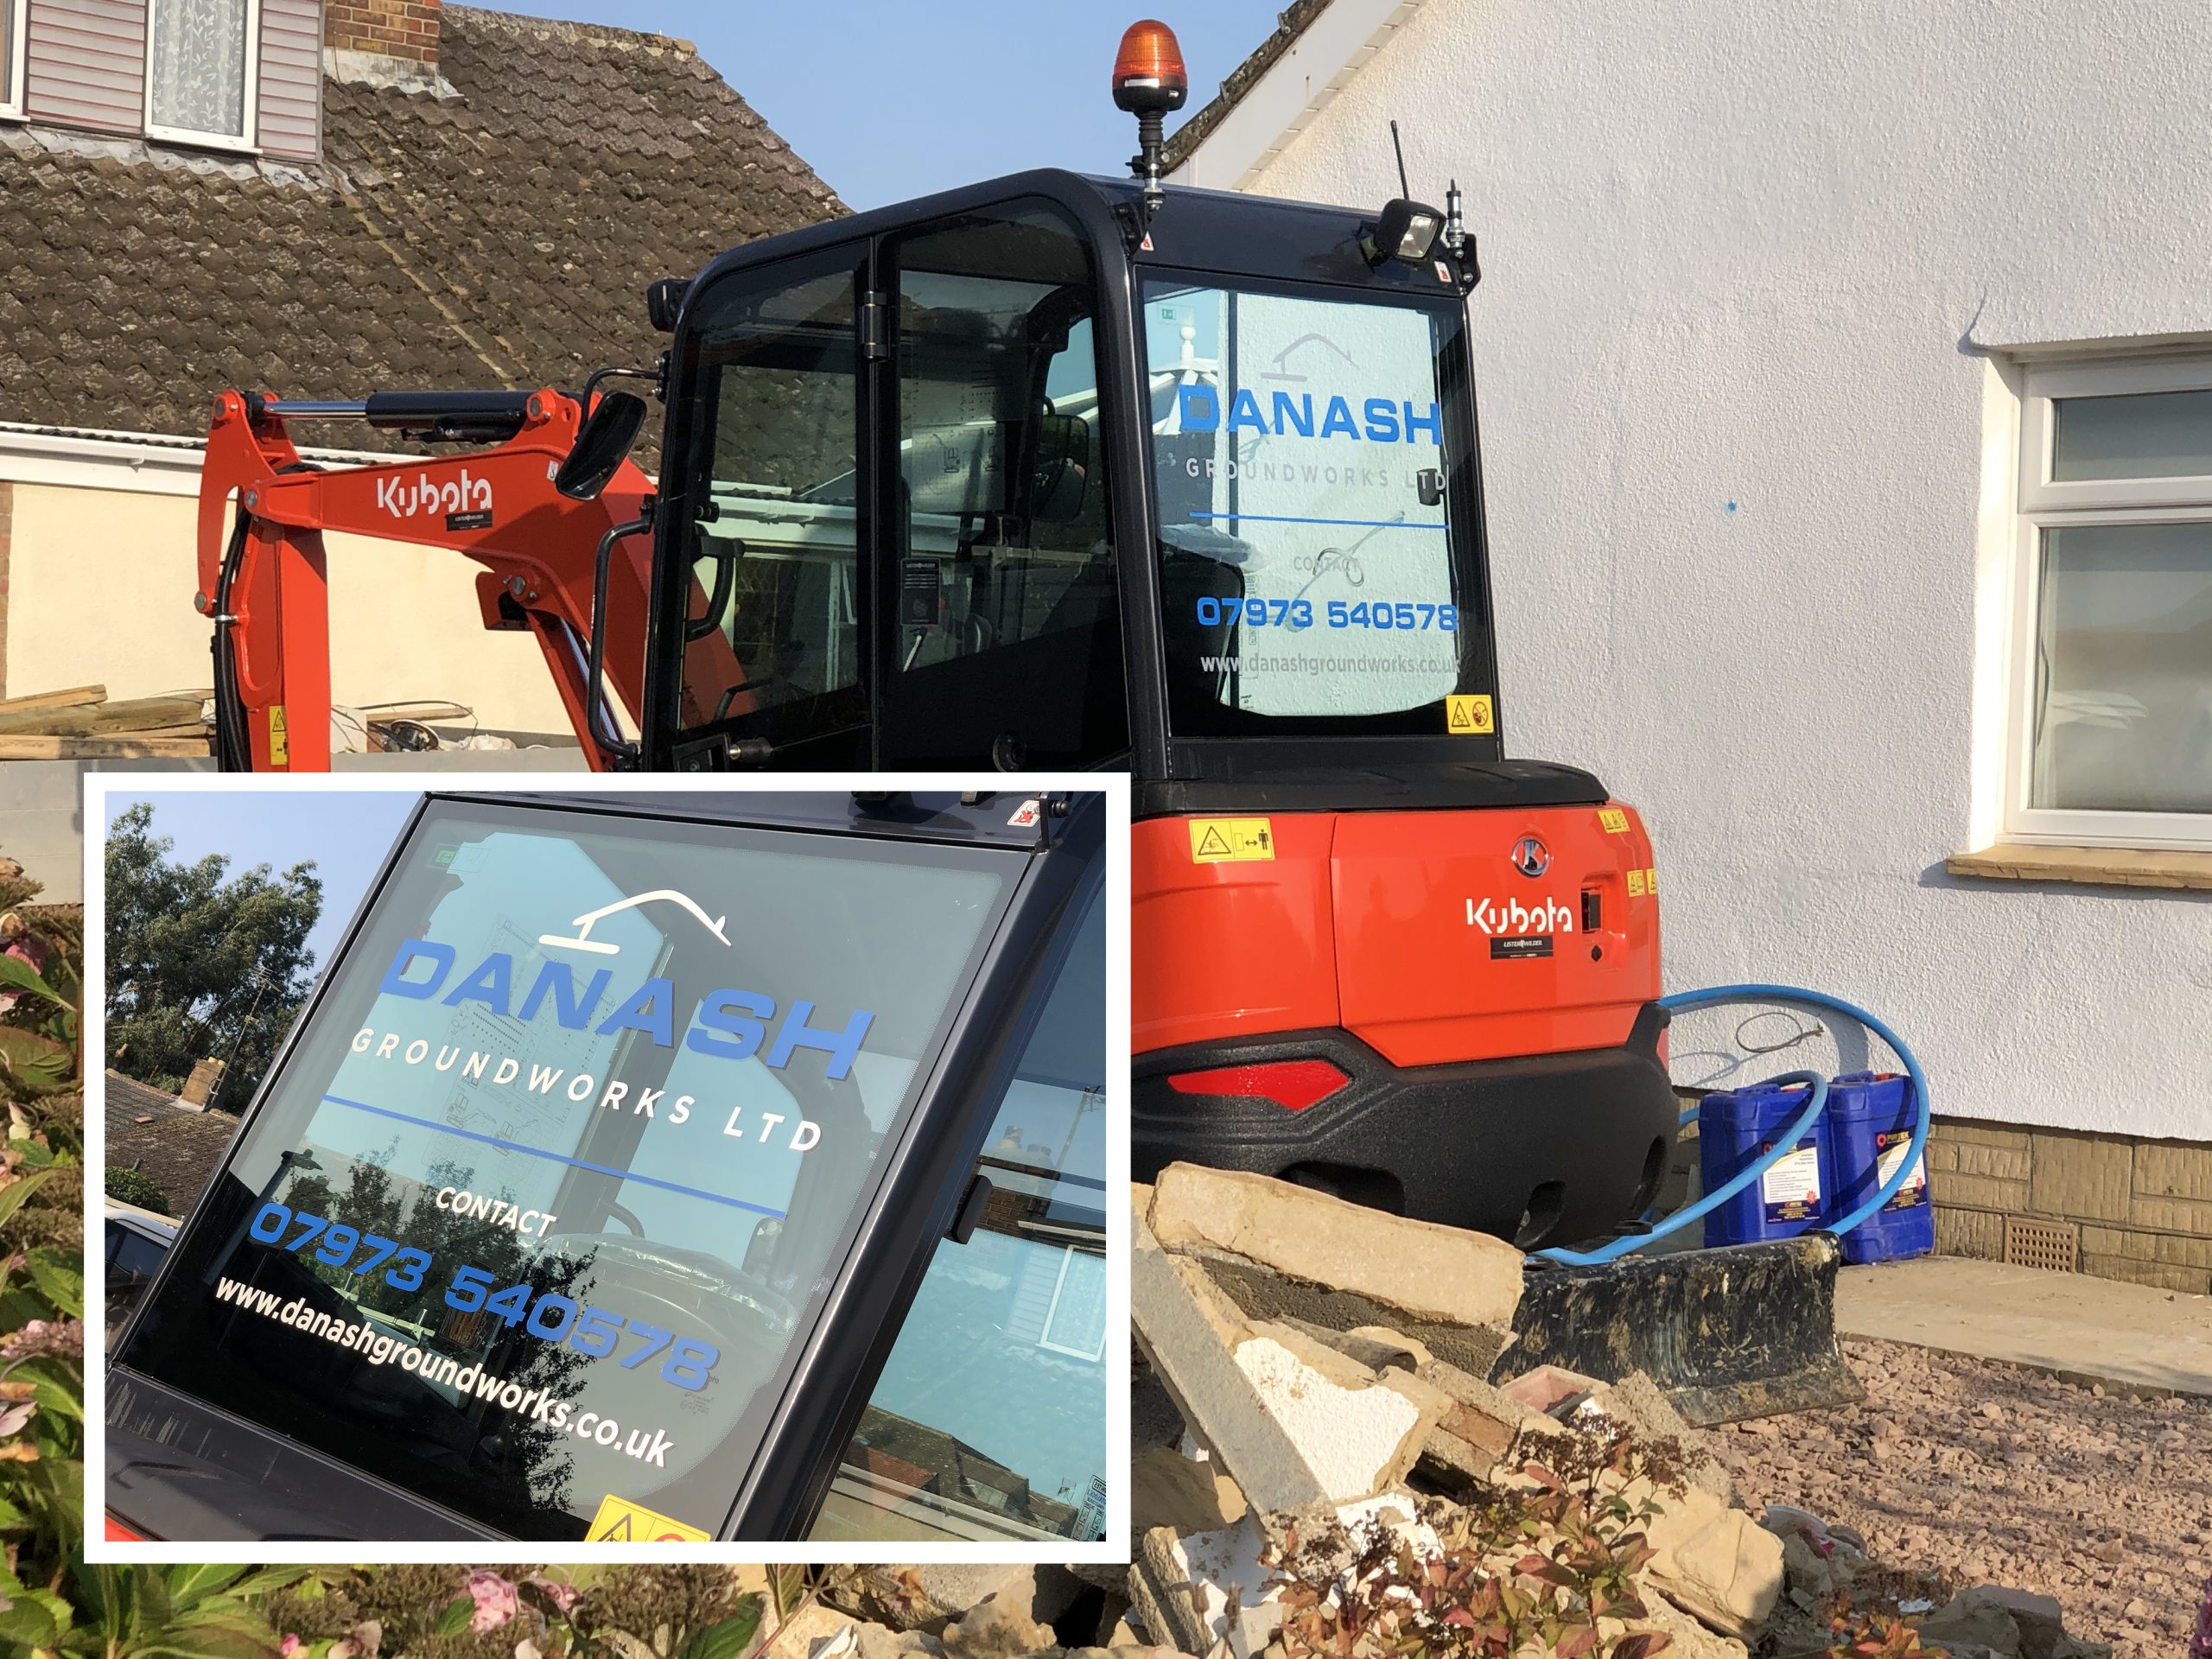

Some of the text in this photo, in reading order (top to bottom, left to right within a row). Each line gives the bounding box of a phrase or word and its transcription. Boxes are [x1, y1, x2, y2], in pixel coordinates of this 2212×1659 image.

[1179, 384, 1442, 445] DANASH
[378, 469, 492, 517] Kubota
[1185, 459, 1446, 491] GROUNDWORKS LTD
[1197, 597, 1459, 631] 07973 540578
[1201, 654, 1460, 677] www.danashgroundworks.co.uk
[1465, 897, 1573, 934] Kubota
[378, 938, 875, 1079] DANASH
[351, 1027, 823, 1153] GROUNDWORKS LTD
[435, 1186, 557, 1239] CONTACT
[249, 1203, 720, 1392] 07973 540578
[214, 1276, 675, 1467] www.danashgroundworks.co.uk
